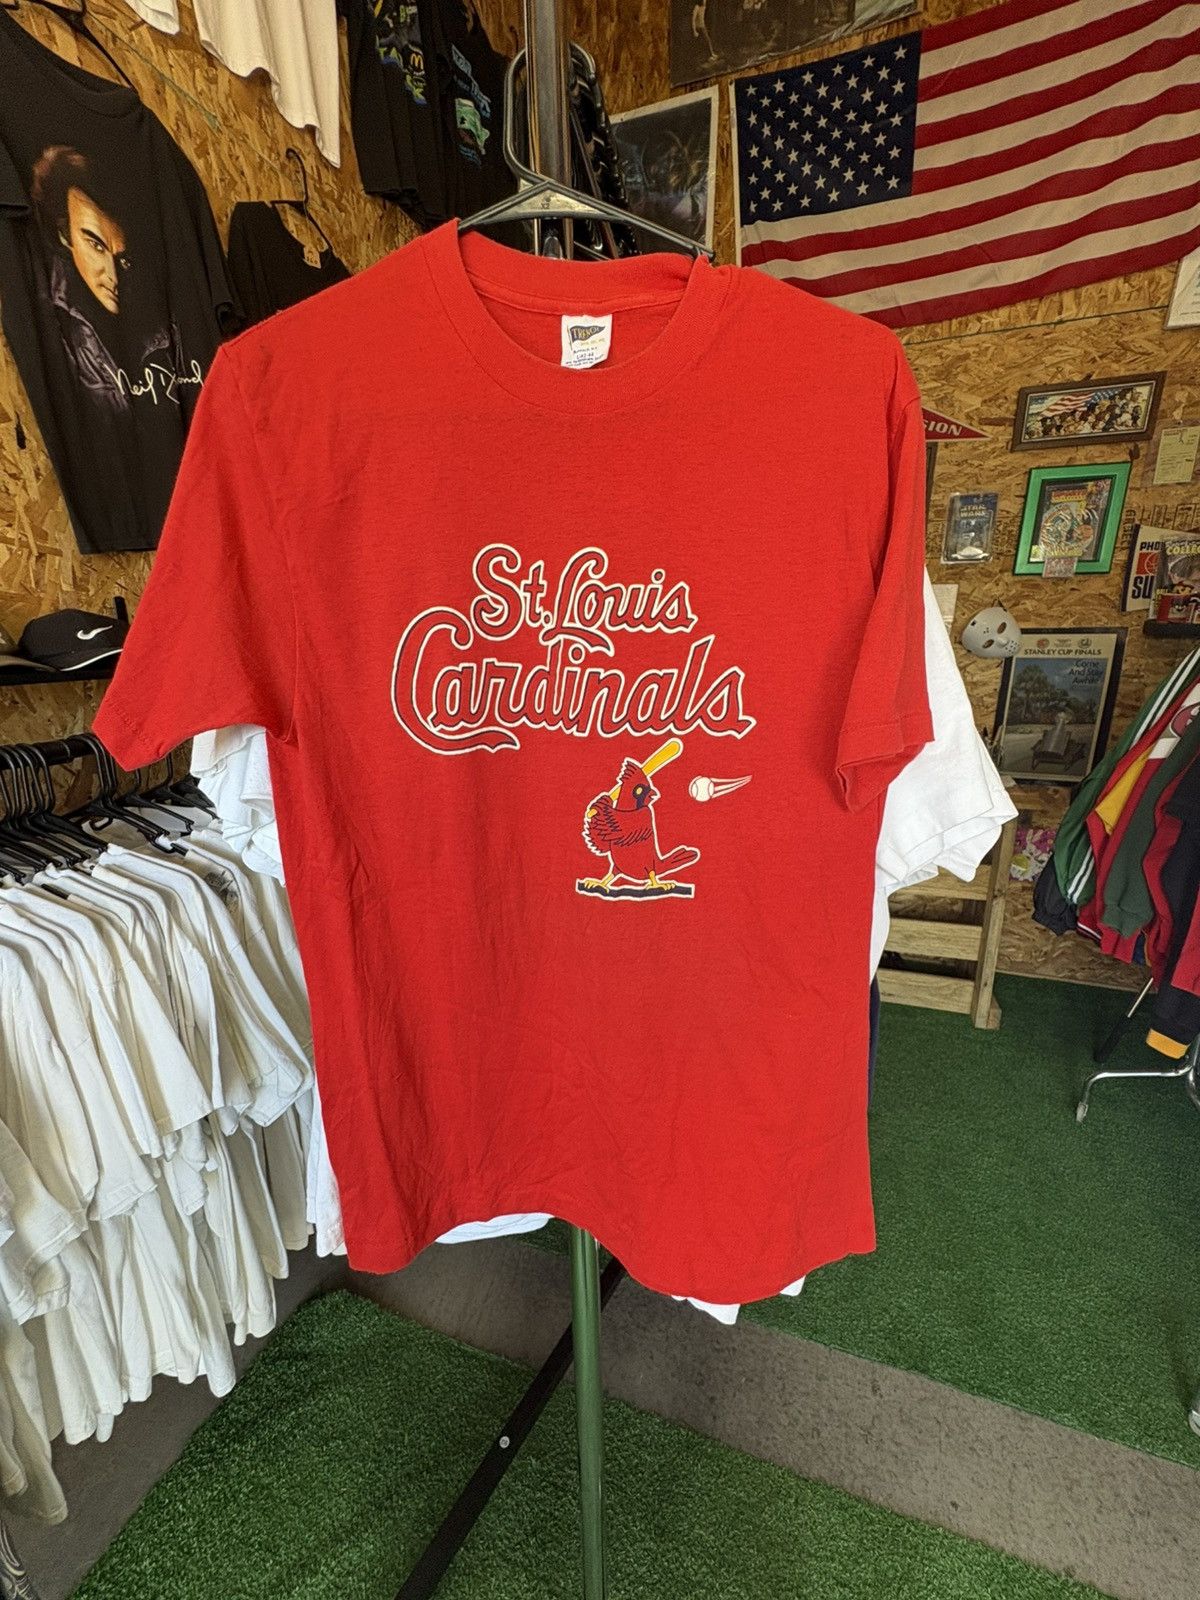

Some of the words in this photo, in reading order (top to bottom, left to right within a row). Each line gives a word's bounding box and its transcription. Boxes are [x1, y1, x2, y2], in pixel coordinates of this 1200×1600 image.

[104, 363, 158, 405] Neil
[539, 546, 698, 656] Louis
[391, 606, 756, 755] Cardinals
[1074, 648, 1102, 656] FINALS
